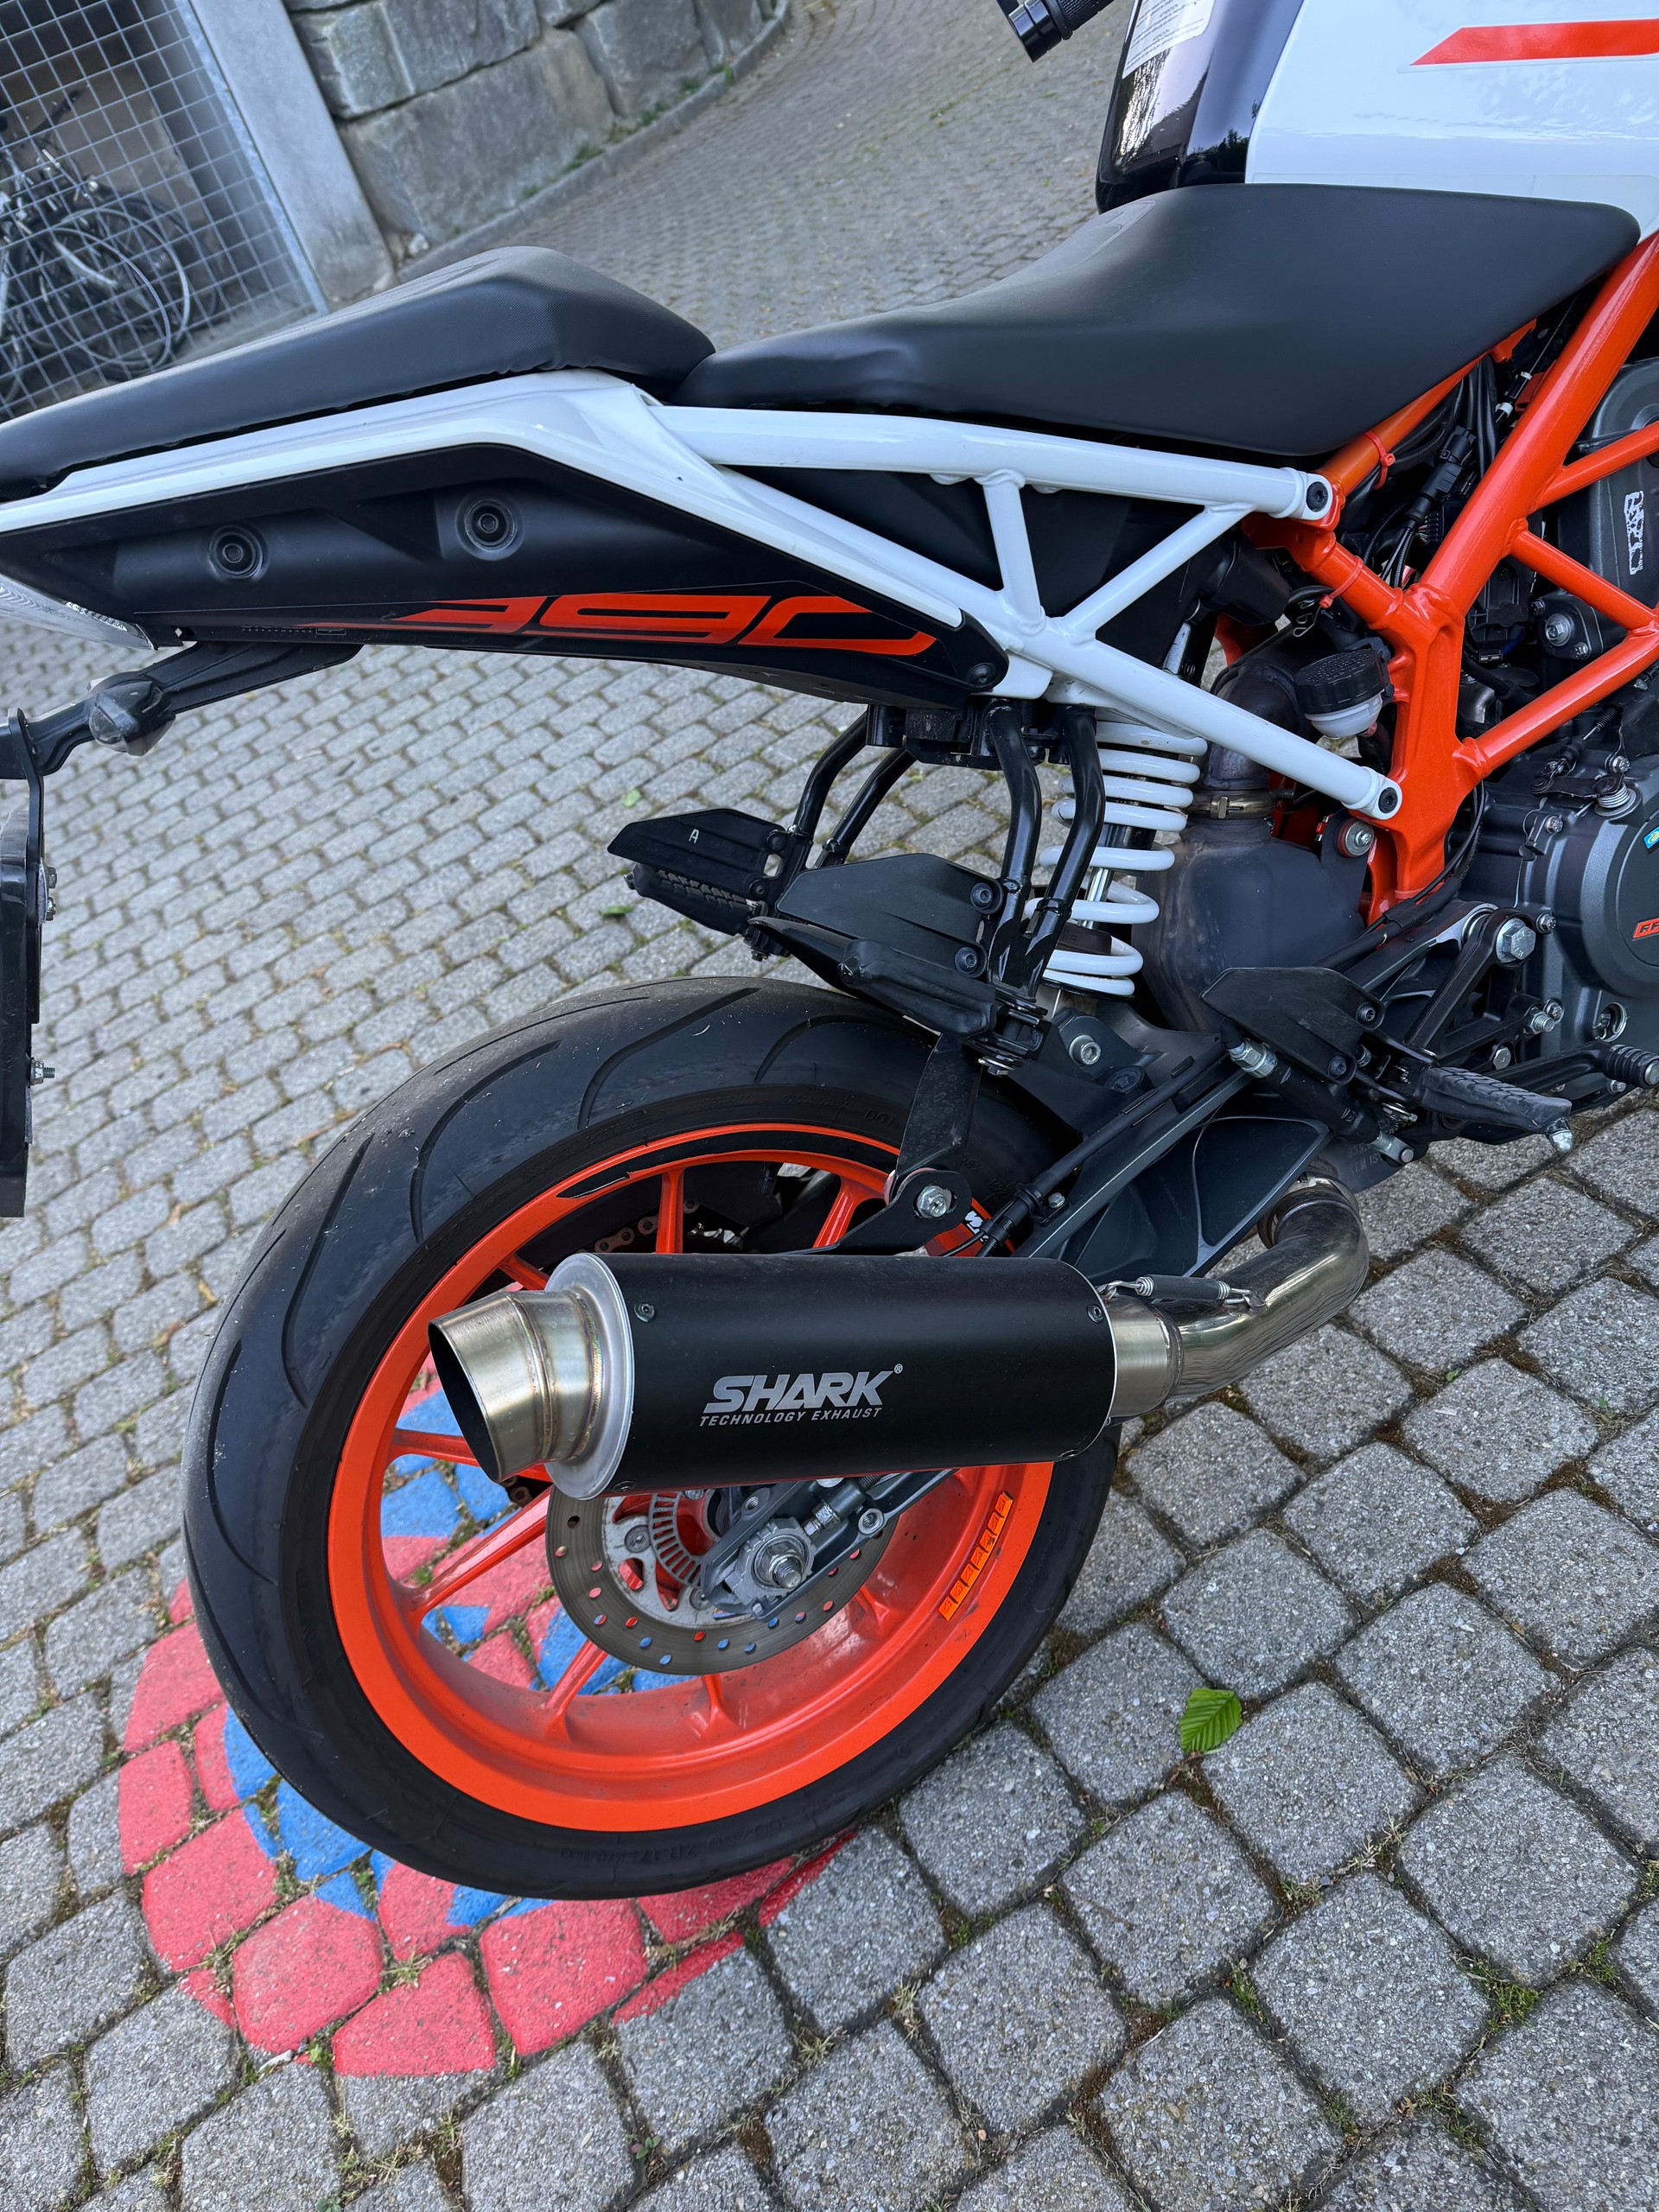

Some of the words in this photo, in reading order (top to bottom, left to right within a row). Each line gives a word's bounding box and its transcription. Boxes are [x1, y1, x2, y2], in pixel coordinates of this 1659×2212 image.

[688, 828, 700, 844] A
[698, 1411, 807, 1427] TECHNOLOGY
[810, 1407, 883, 1421] EXHAUST
